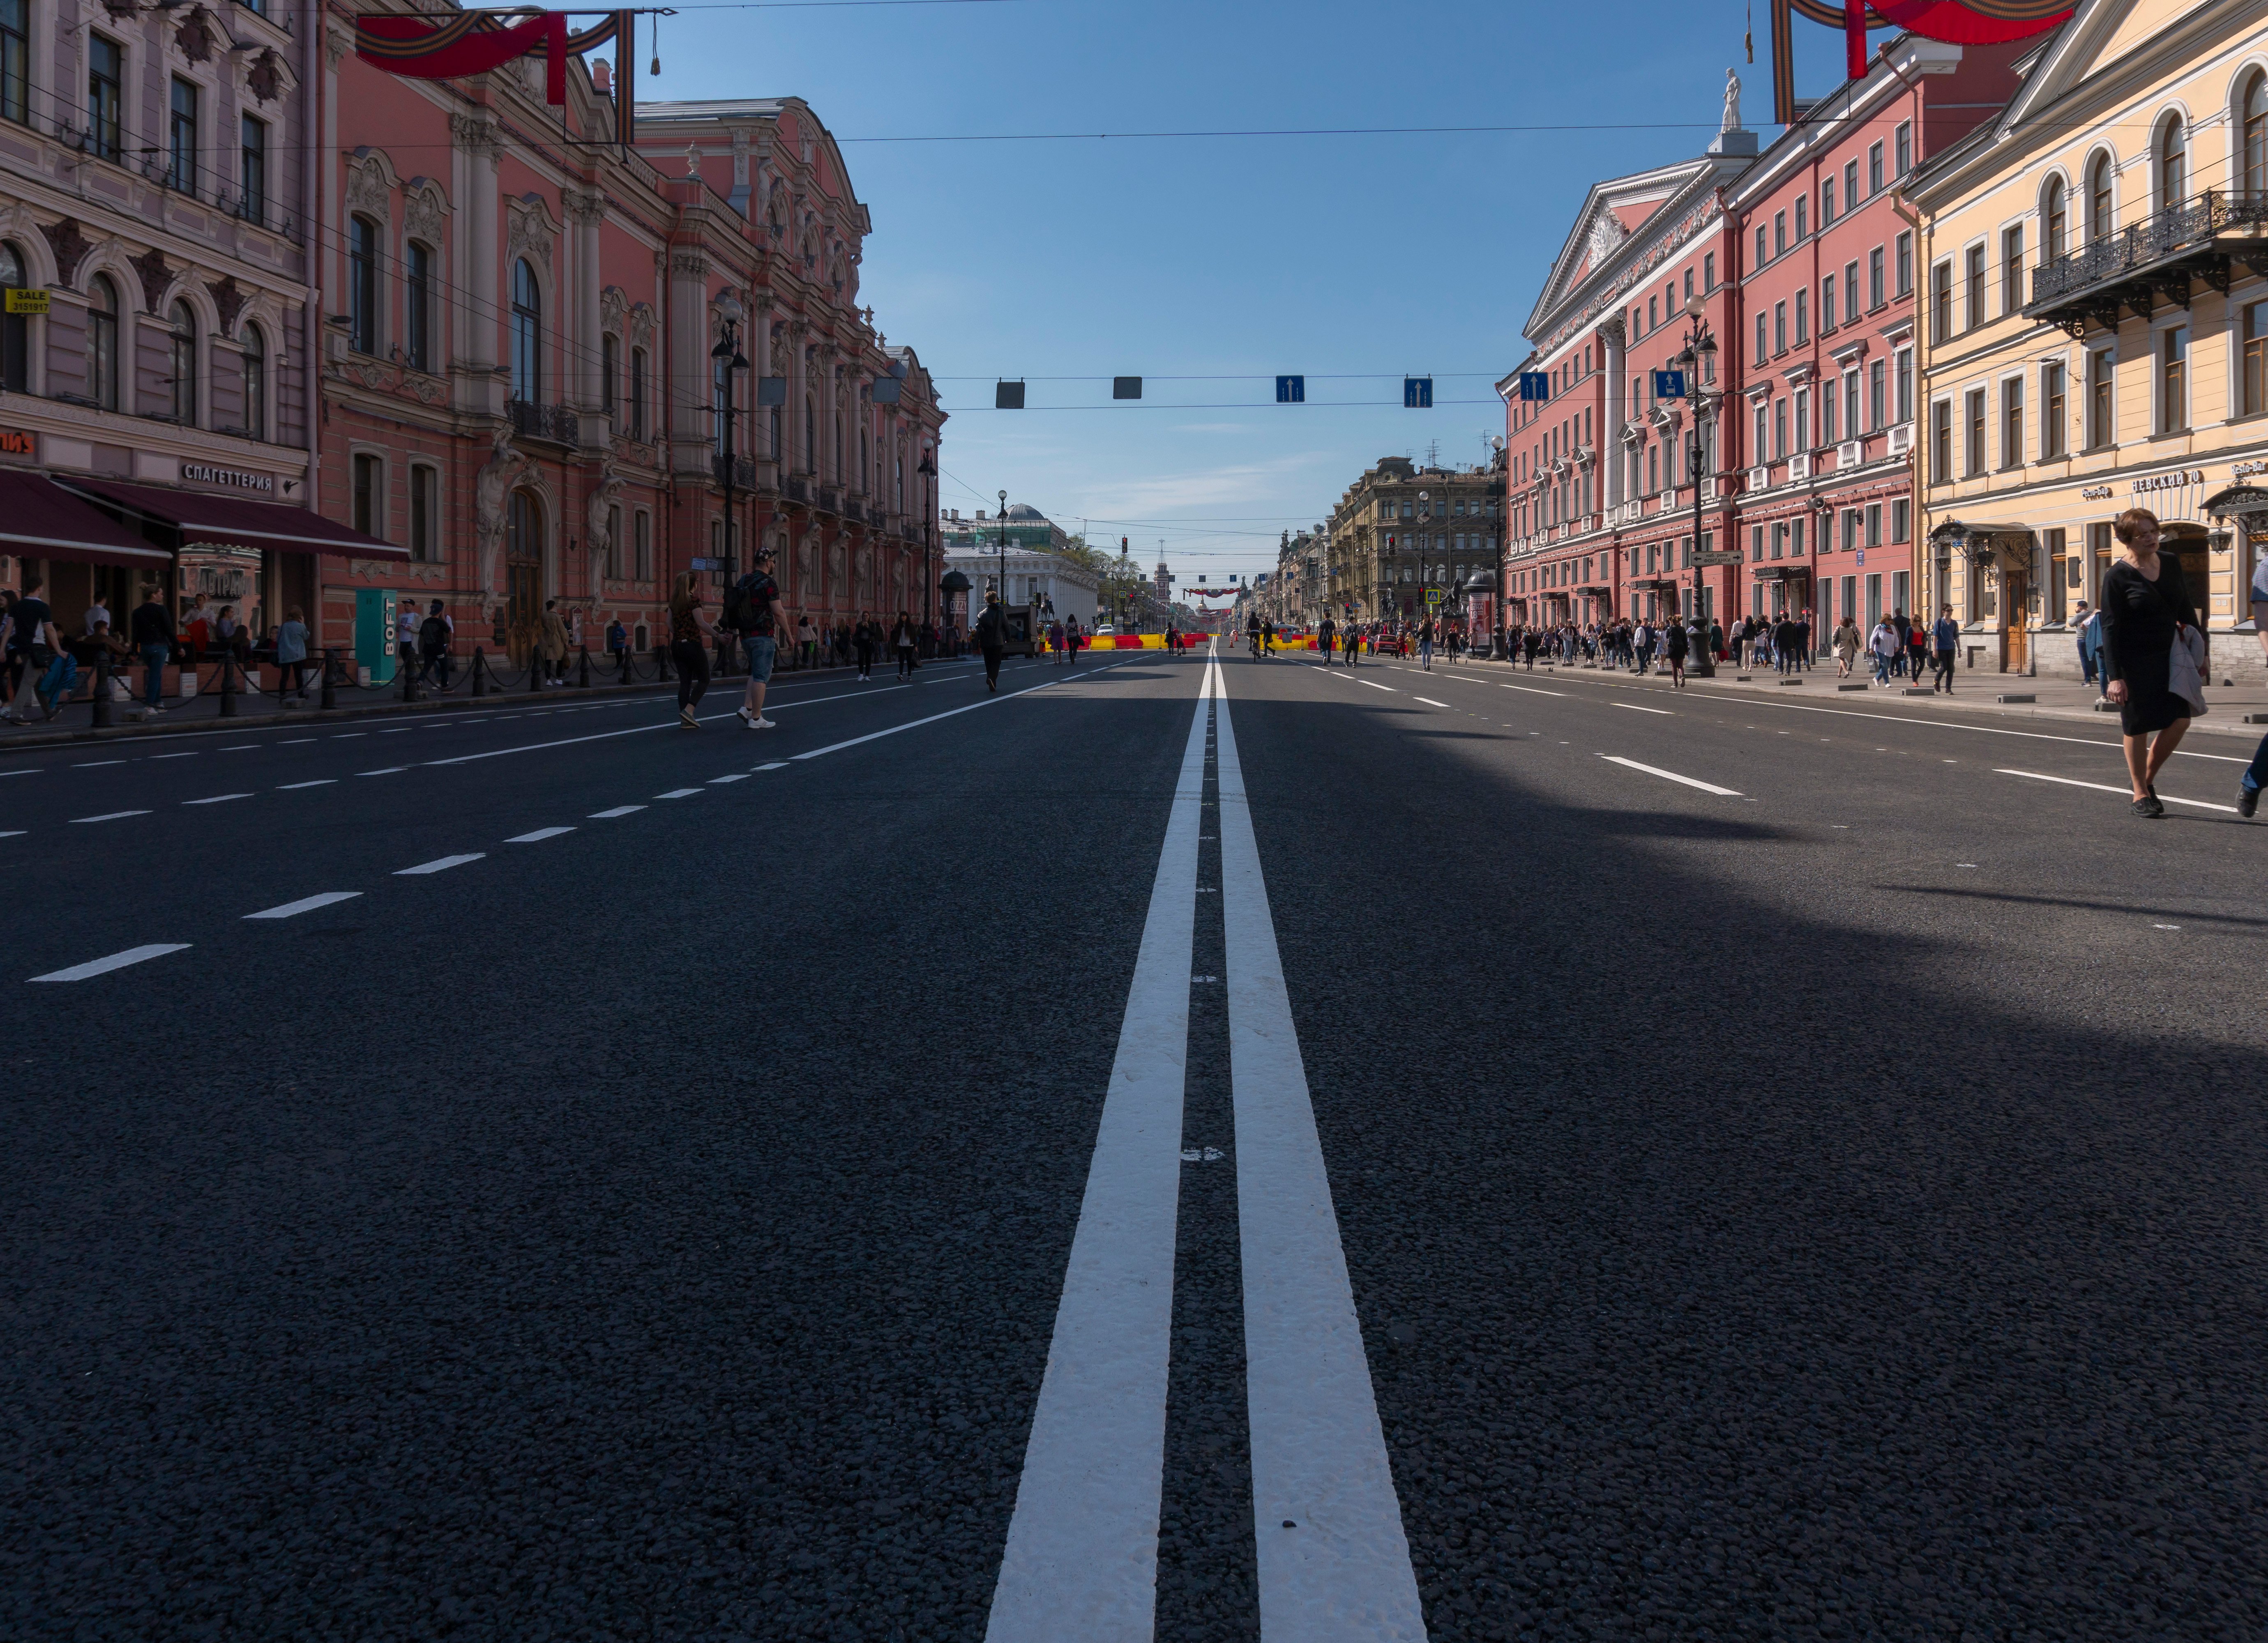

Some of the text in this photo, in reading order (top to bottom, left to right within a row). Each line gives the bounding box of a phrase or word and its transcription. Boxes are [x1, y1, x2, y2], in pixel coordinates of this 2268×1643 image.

[16, 291, 46, 300] SALE
[13, 303, 49, 311] 3151917
[2230, 461, 2266, 475] Resto-Bar
[185, 464, 272, 490] СПАГЕТТЕРИЯ
[2132, 470, 2199, 491] НЕВСКИЙ 70
[2081, 486, 2108, 497] Ресто-Бар
[950, 601, 967, 610] OZZY
[385, 598, 395, 655] BOFT
